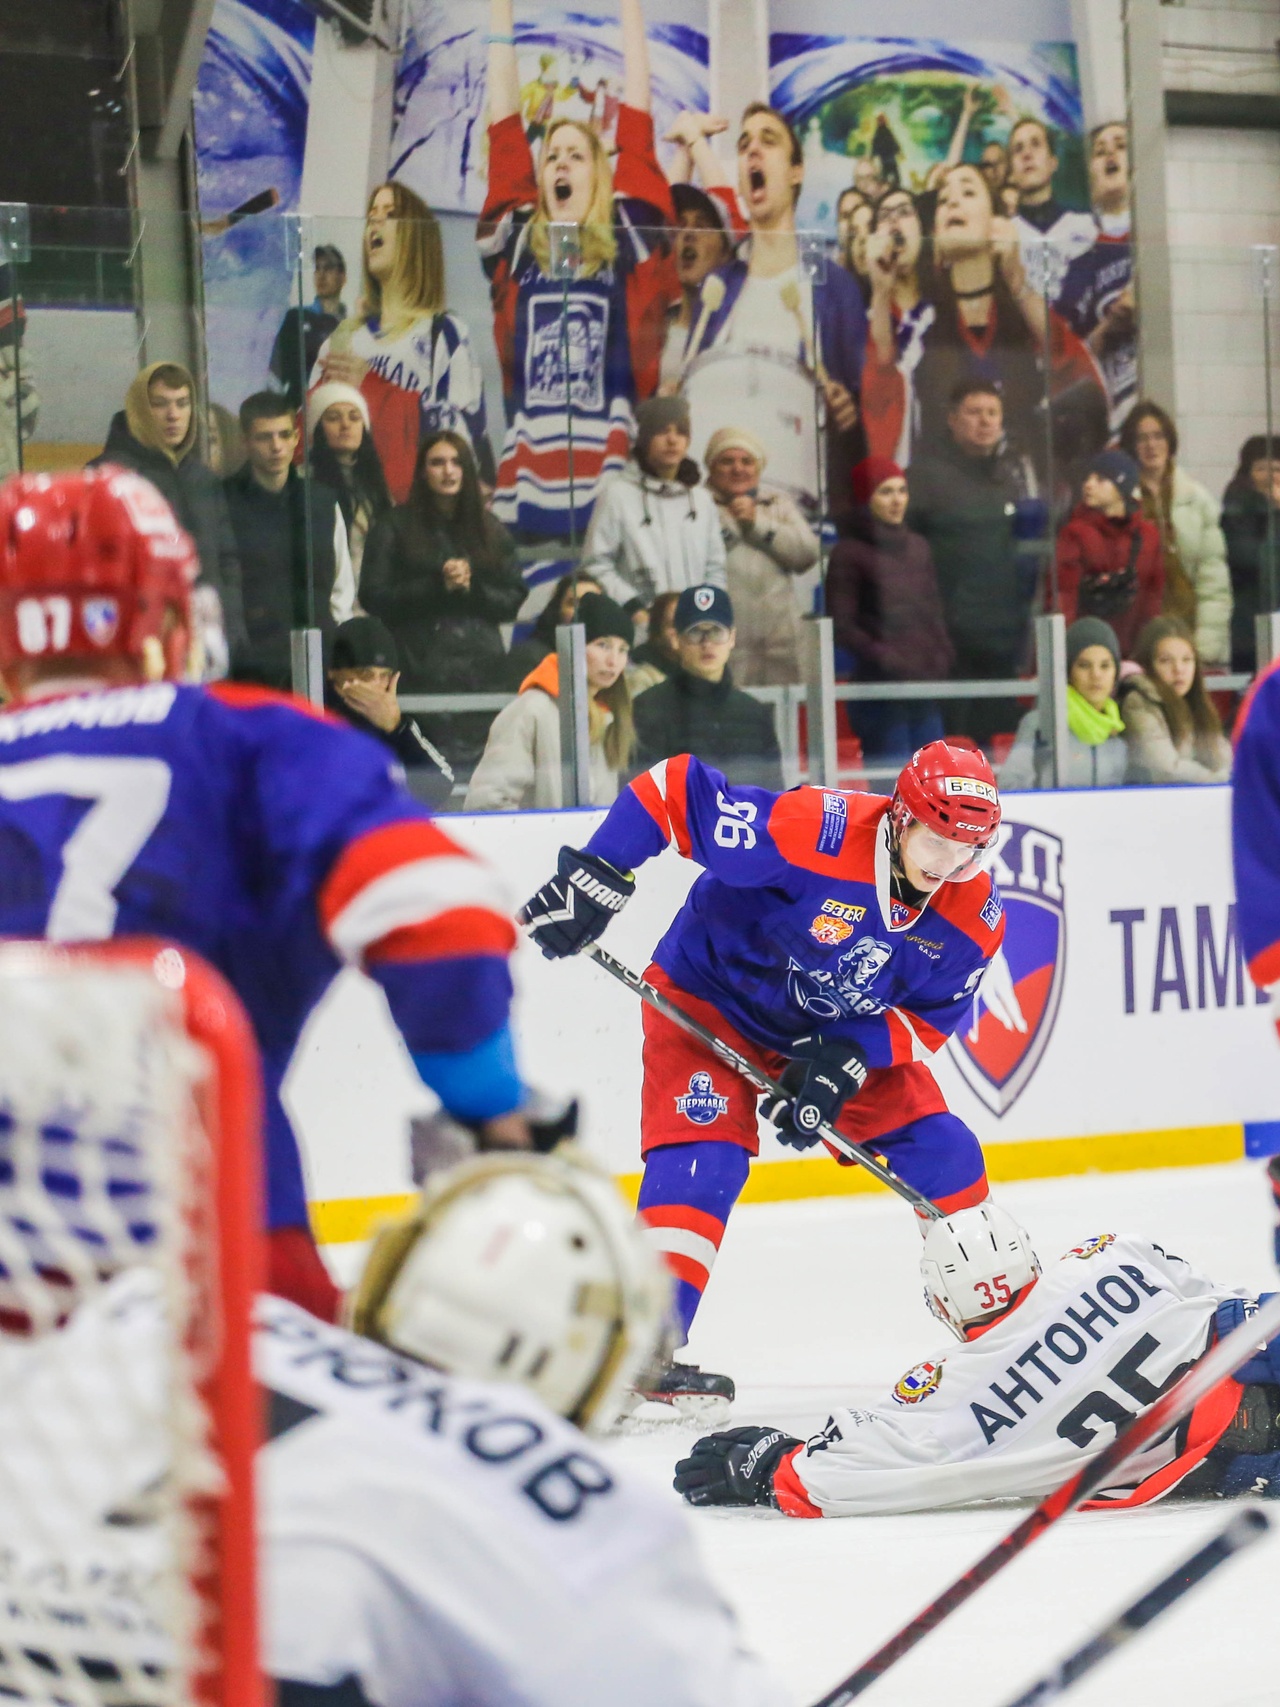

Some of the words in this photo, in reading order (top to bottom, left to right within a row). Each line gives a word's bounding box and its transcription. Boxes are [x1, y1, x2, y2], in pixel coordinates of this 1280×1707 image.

[955, 821, 987, 832] CCM
[1109, 904, 1273, 1014] ТАМ
[680, 1097, 726, 1111] ДЕРЖАВА
[973, 1274, 1013, 1310] 35
[969, 1264, 1164, 1446] АНТОНОВ
